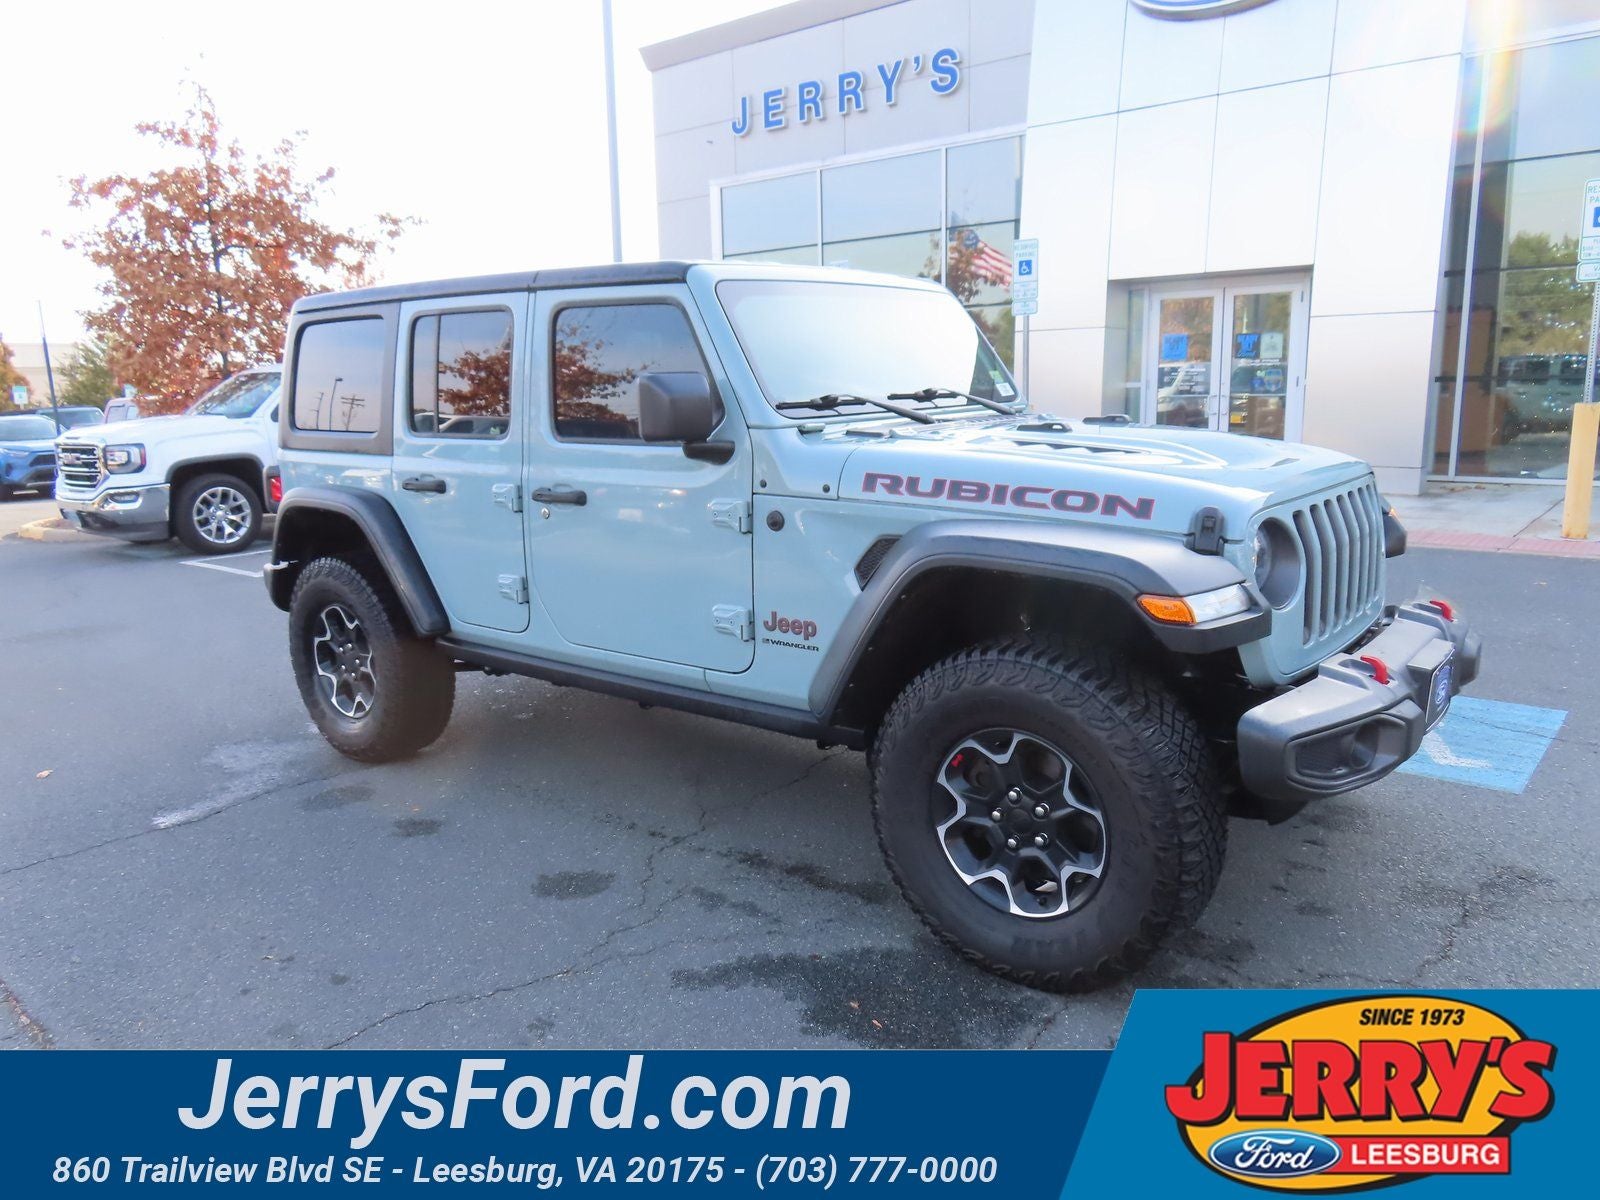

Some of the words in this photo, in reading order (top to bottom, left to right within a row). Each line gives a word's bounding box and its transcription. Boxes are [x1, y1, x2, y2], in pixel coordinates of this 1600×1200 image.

[731, 48, 960, 135] JERRY'S
[862, 472, 1155, 520] RUBICON
[763, 611, 817, 640] Jeep
[770, 639, 819, 652] WRANGLER
